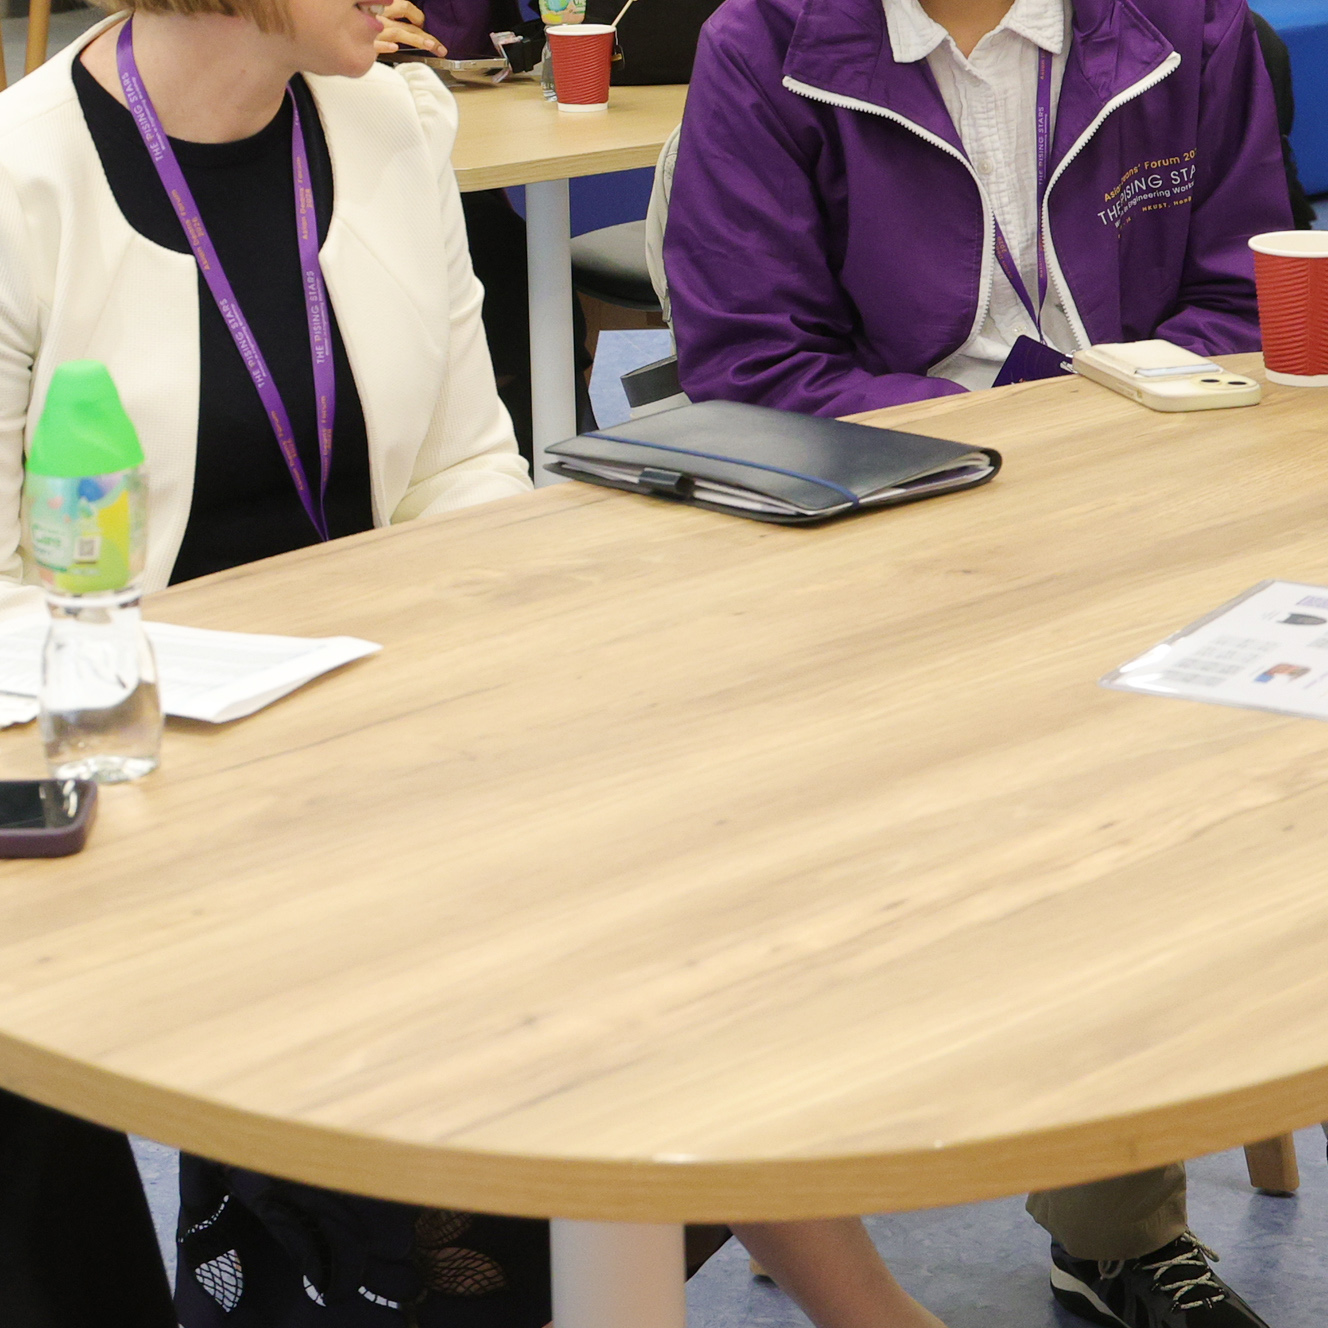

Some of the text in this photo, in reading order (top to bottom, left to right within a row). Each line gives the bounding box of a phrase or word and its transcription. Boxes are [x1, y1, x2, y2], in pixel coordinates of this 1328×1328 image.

[121, 72, 139, 103] STARS
[150, 142, 164, 161] THE
[1144, 156, 1180, 170] Forum
[1183, 147, 1197, 161] 20
[306, 270, 318, 301] STARS
[219, 298, 239, 329] STARS
[315, 345, 325, 364] THE
[252, 369, 265, 388] THE
